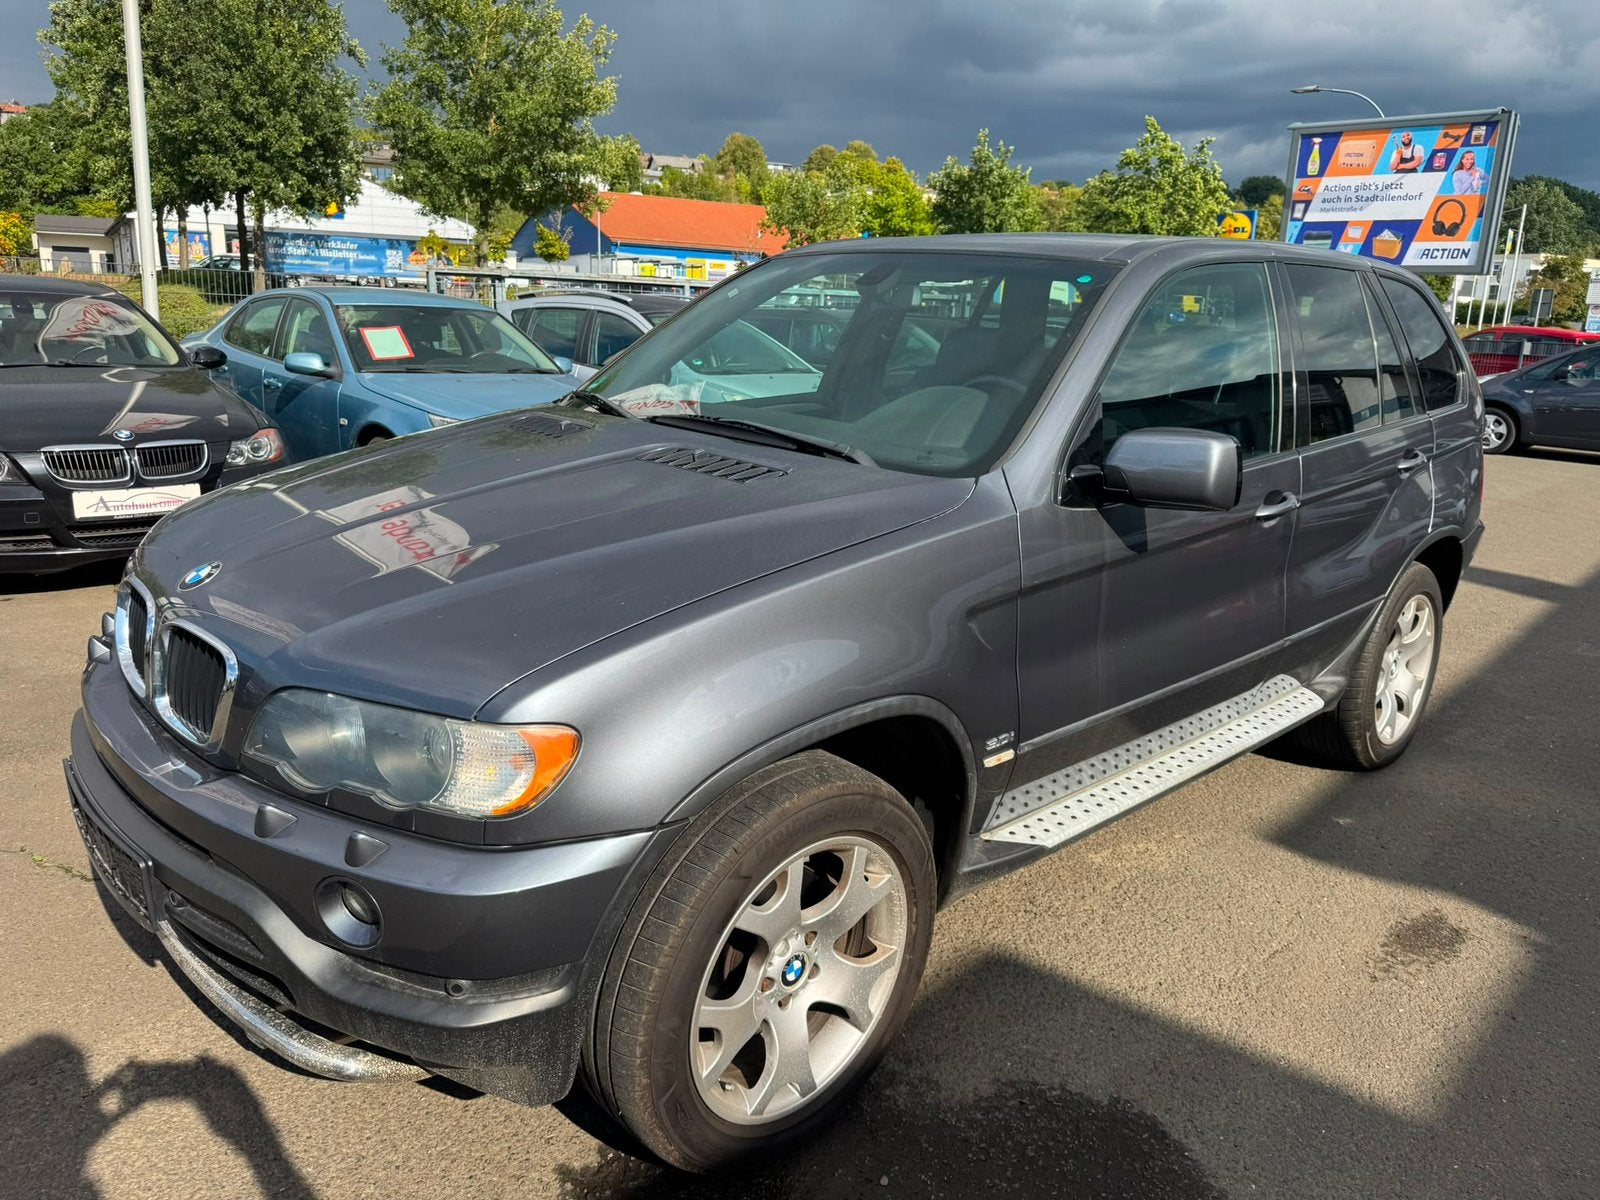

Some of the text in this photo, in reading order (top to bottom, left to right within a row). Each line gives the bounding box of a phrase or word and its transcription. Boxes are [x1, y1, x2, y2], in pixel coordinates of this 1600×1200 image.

[1323, 181, 1404, 193] Action gibt's jetzt
[1321, 191, 1424, 204] auch in Stadtallendorf
[318, 240, 358, 250] Verkäufer
[1420, 248, 1471, 259] ACTION
[93, 495, 157, 513] Autohaus
